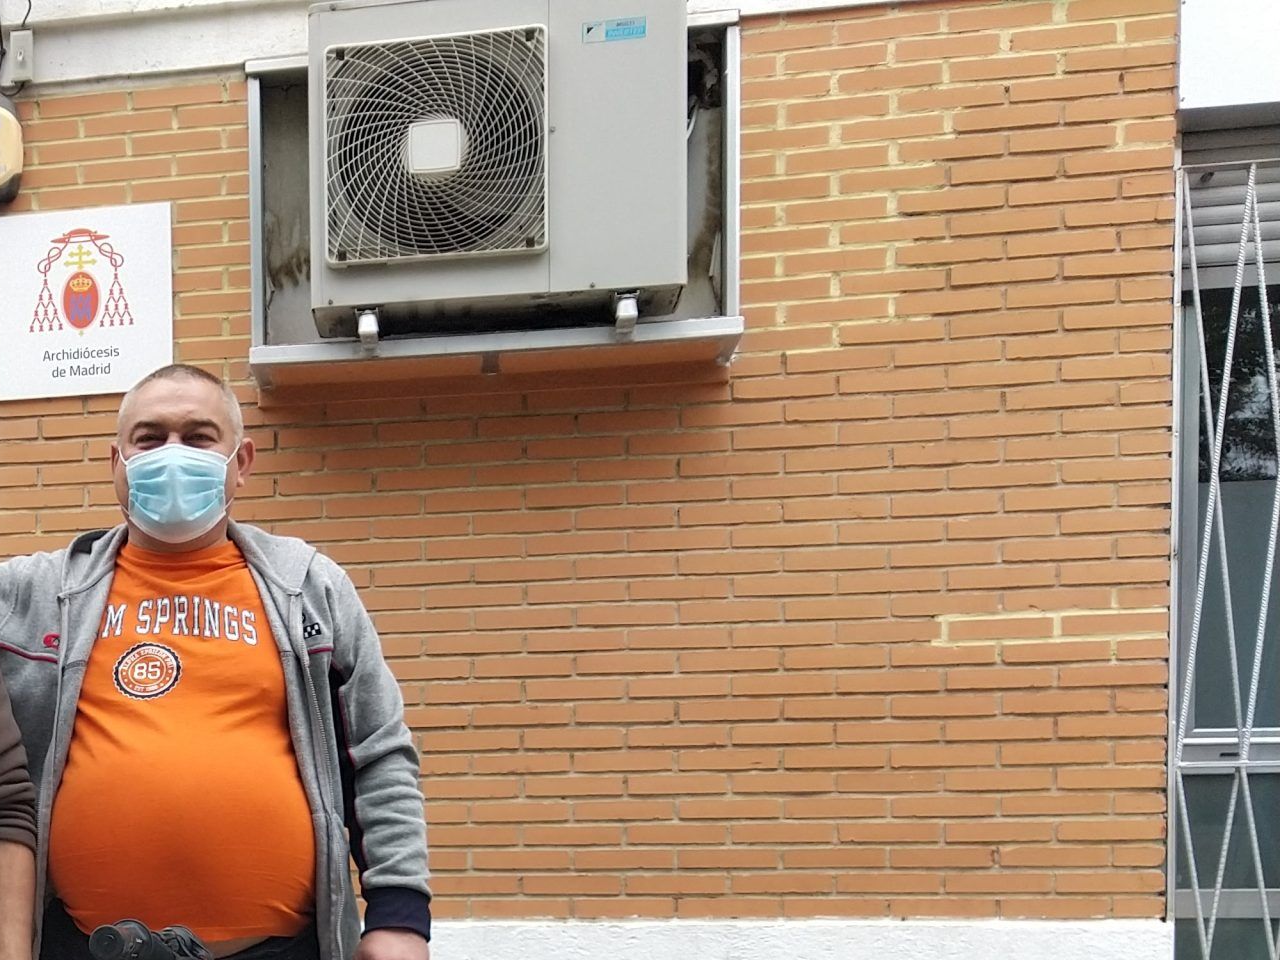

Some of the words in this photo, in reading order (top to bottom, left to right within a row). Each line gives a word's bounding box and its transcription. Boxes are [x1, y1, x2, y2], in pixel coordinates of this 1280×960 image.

[42, 345, 120, 362] Archidiócesis
[51, 366, 67, 378] de
[69, 362, 111, 376] Madrid
[135, 595, 258, 645] SPRINGS
[133, 661, 160, 680] 85
